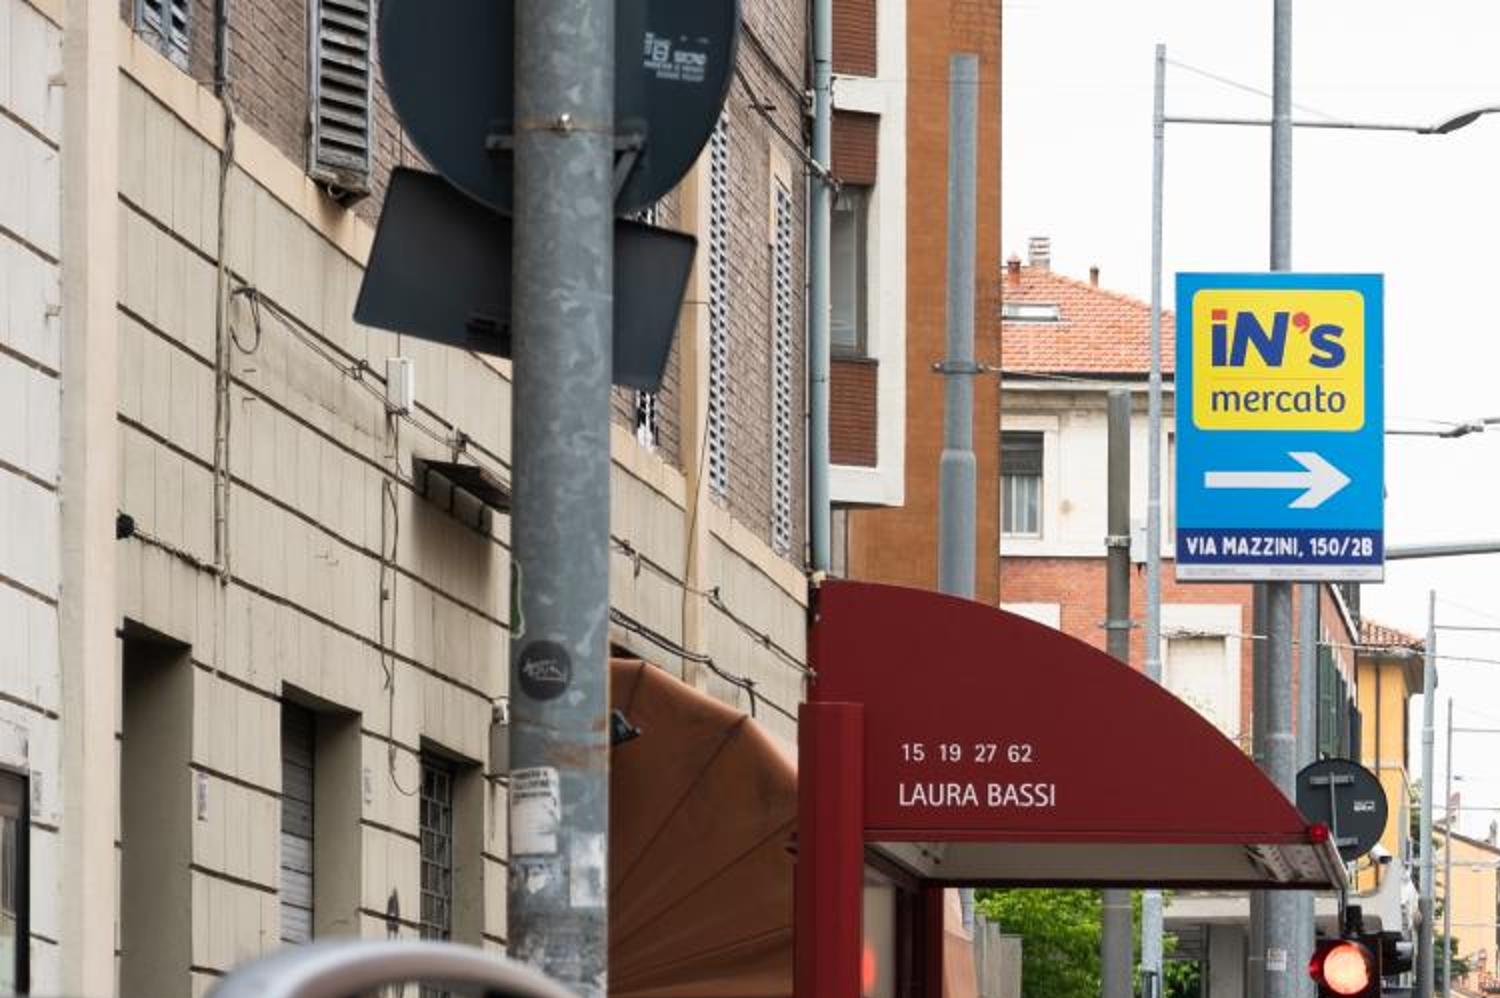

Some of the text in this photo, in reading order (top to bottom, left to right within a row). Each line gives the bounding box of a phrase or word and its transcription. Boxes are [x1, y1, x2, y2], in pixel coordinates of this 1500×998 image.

[1211, 384, 1346, 413] mercato
[1186, 537, 1373, 558] VIA MAZZINI, 150/2B
[901, 743, 1033, 763] 15 19 27 62
[899, 783, 1056, 807] LAURA BASSI
